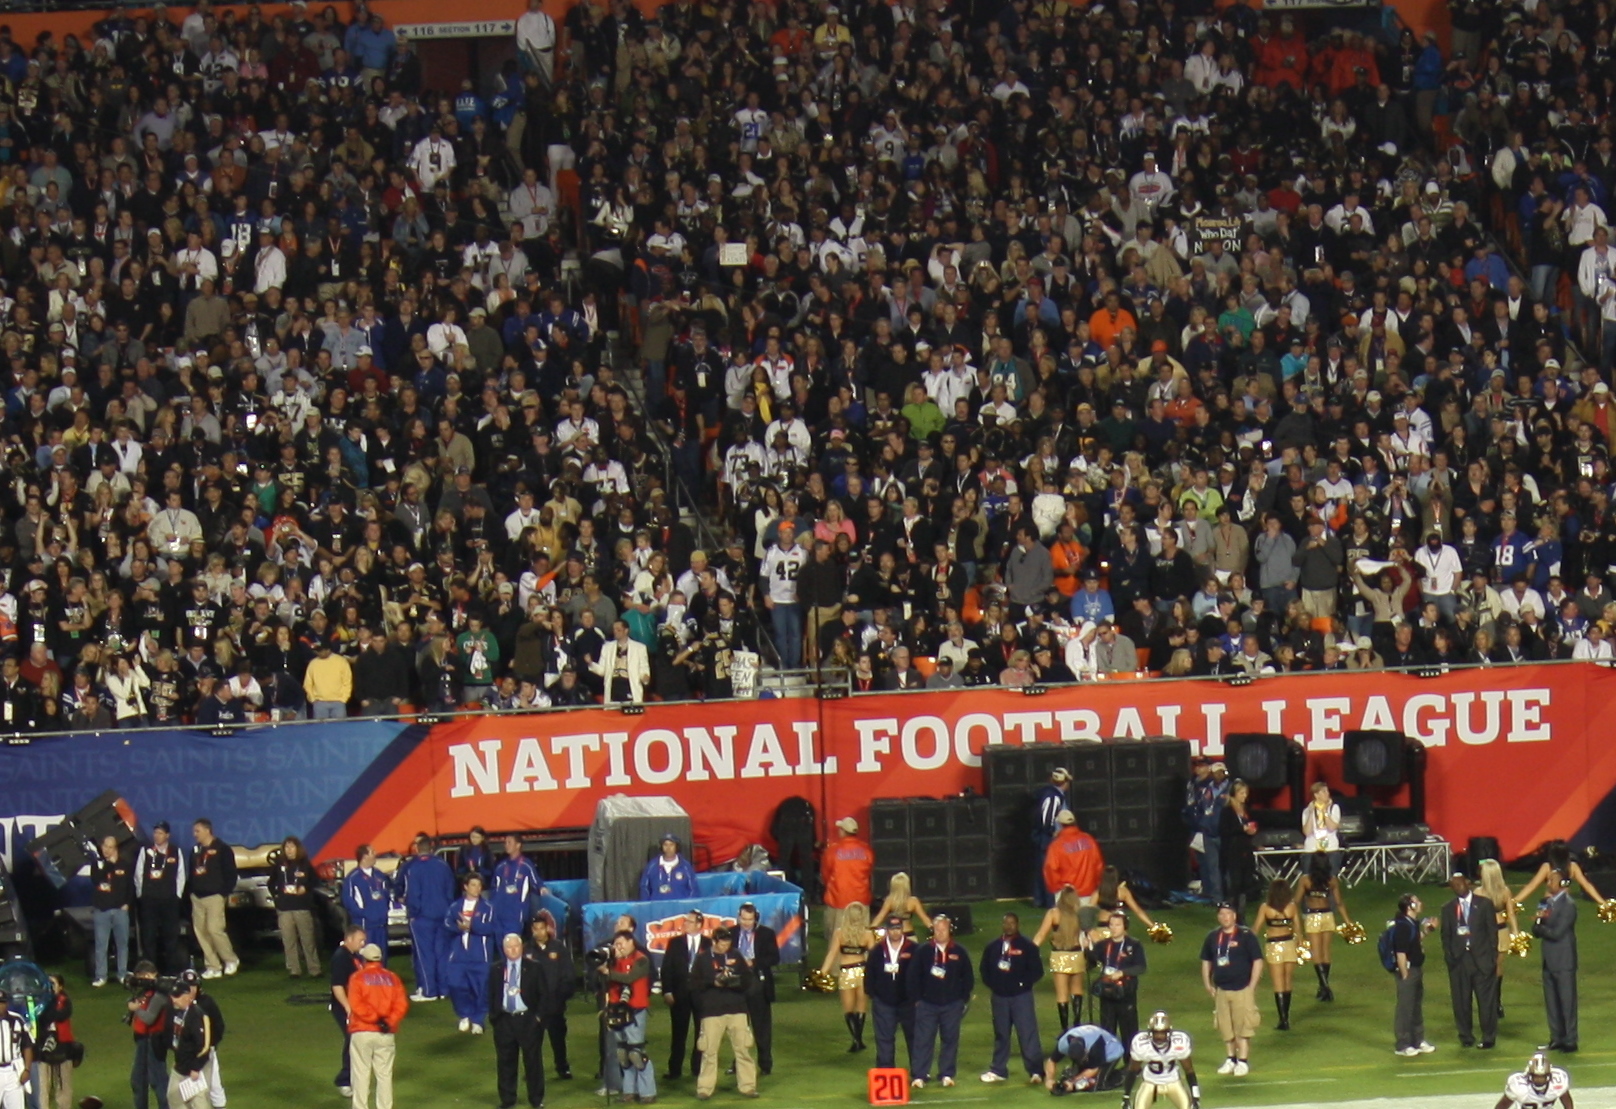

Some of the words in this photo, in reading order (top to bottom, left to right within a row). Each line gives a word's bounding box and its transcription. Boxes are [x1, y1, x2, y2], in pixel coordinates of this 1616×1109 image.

[413, 25, 435, 36] 116
[475, 22, 496, 33] 117
[884, 140, 895, 157] 9
[1494, 544, 1514, 566] 18
[776, 561, 800, 581] 42
[1263, 688, 1551, 751] LEAGUE
[449, 721, 838, 798] NATIONAL
[874, 1074, 903, 1101] 20
